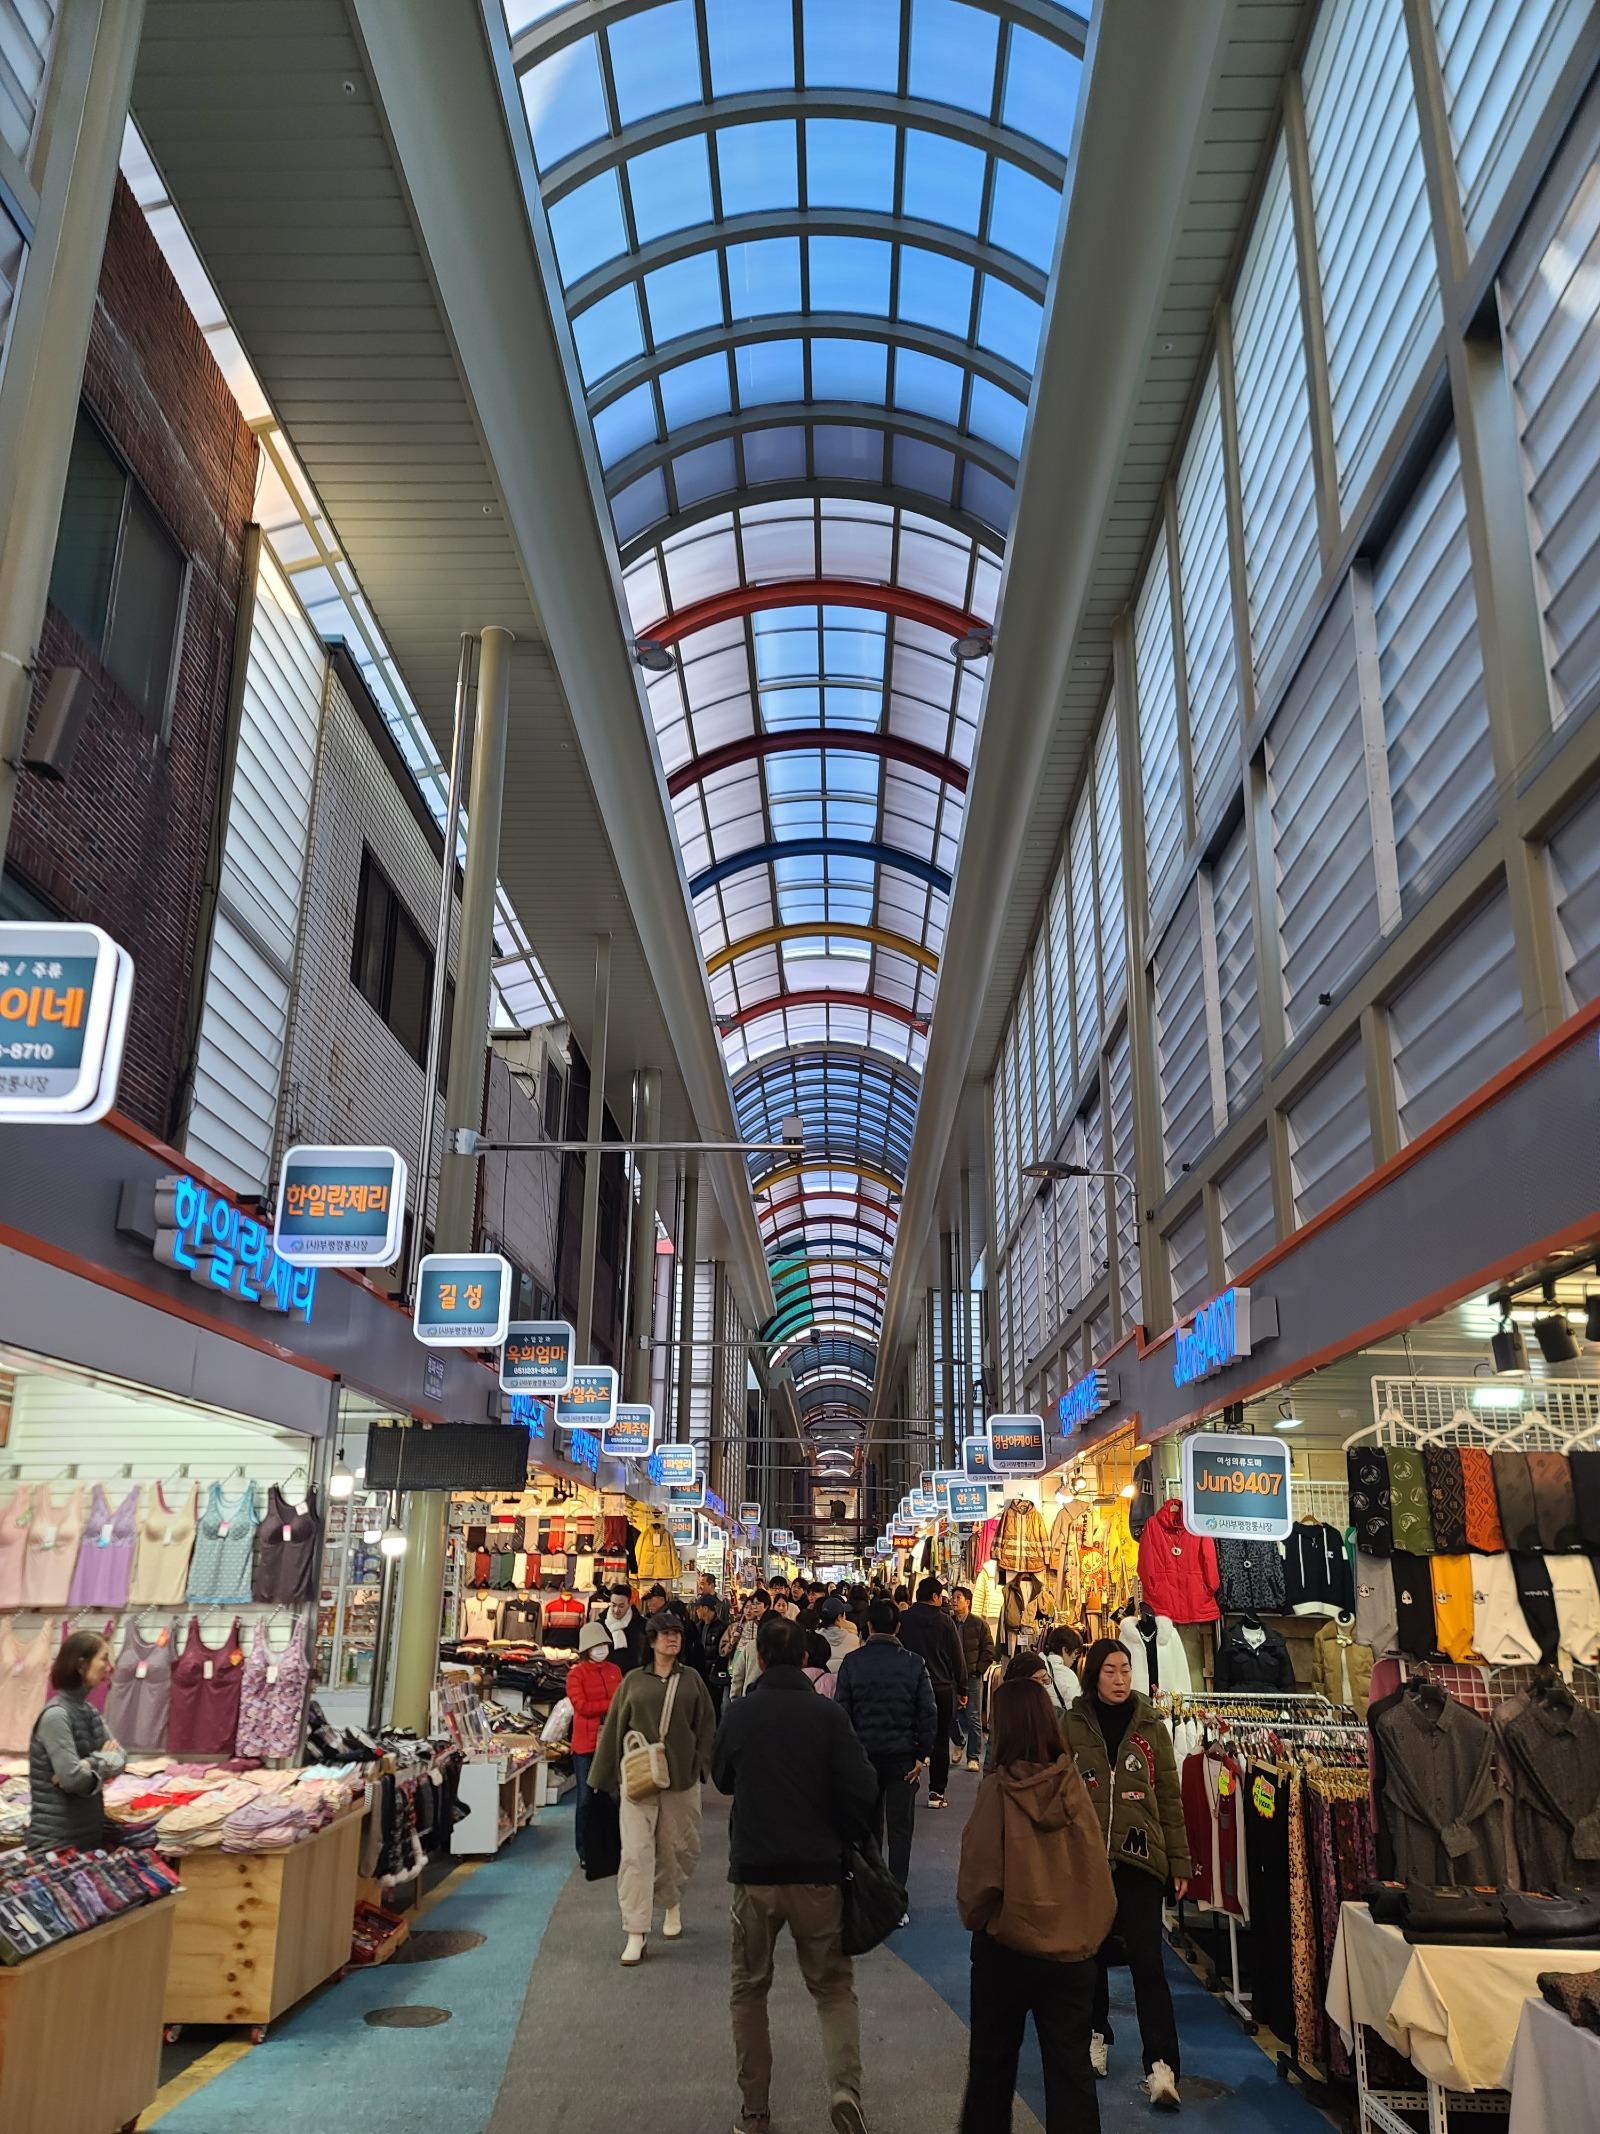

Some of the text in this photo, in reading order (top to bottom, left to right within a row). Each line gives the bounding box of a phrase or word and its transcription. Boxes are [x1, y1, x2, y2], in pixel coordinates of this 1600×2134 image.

[0, 1042, 55, 1060] -8710
[286, 1184, 388, 1217] 한일란제리
[506, 1345, 567, 1365] 옥희엄마
[1217, 1456, 1262, 1467] 여성의류도매
[1196, 1470, 1283, 1496] Jun9407
